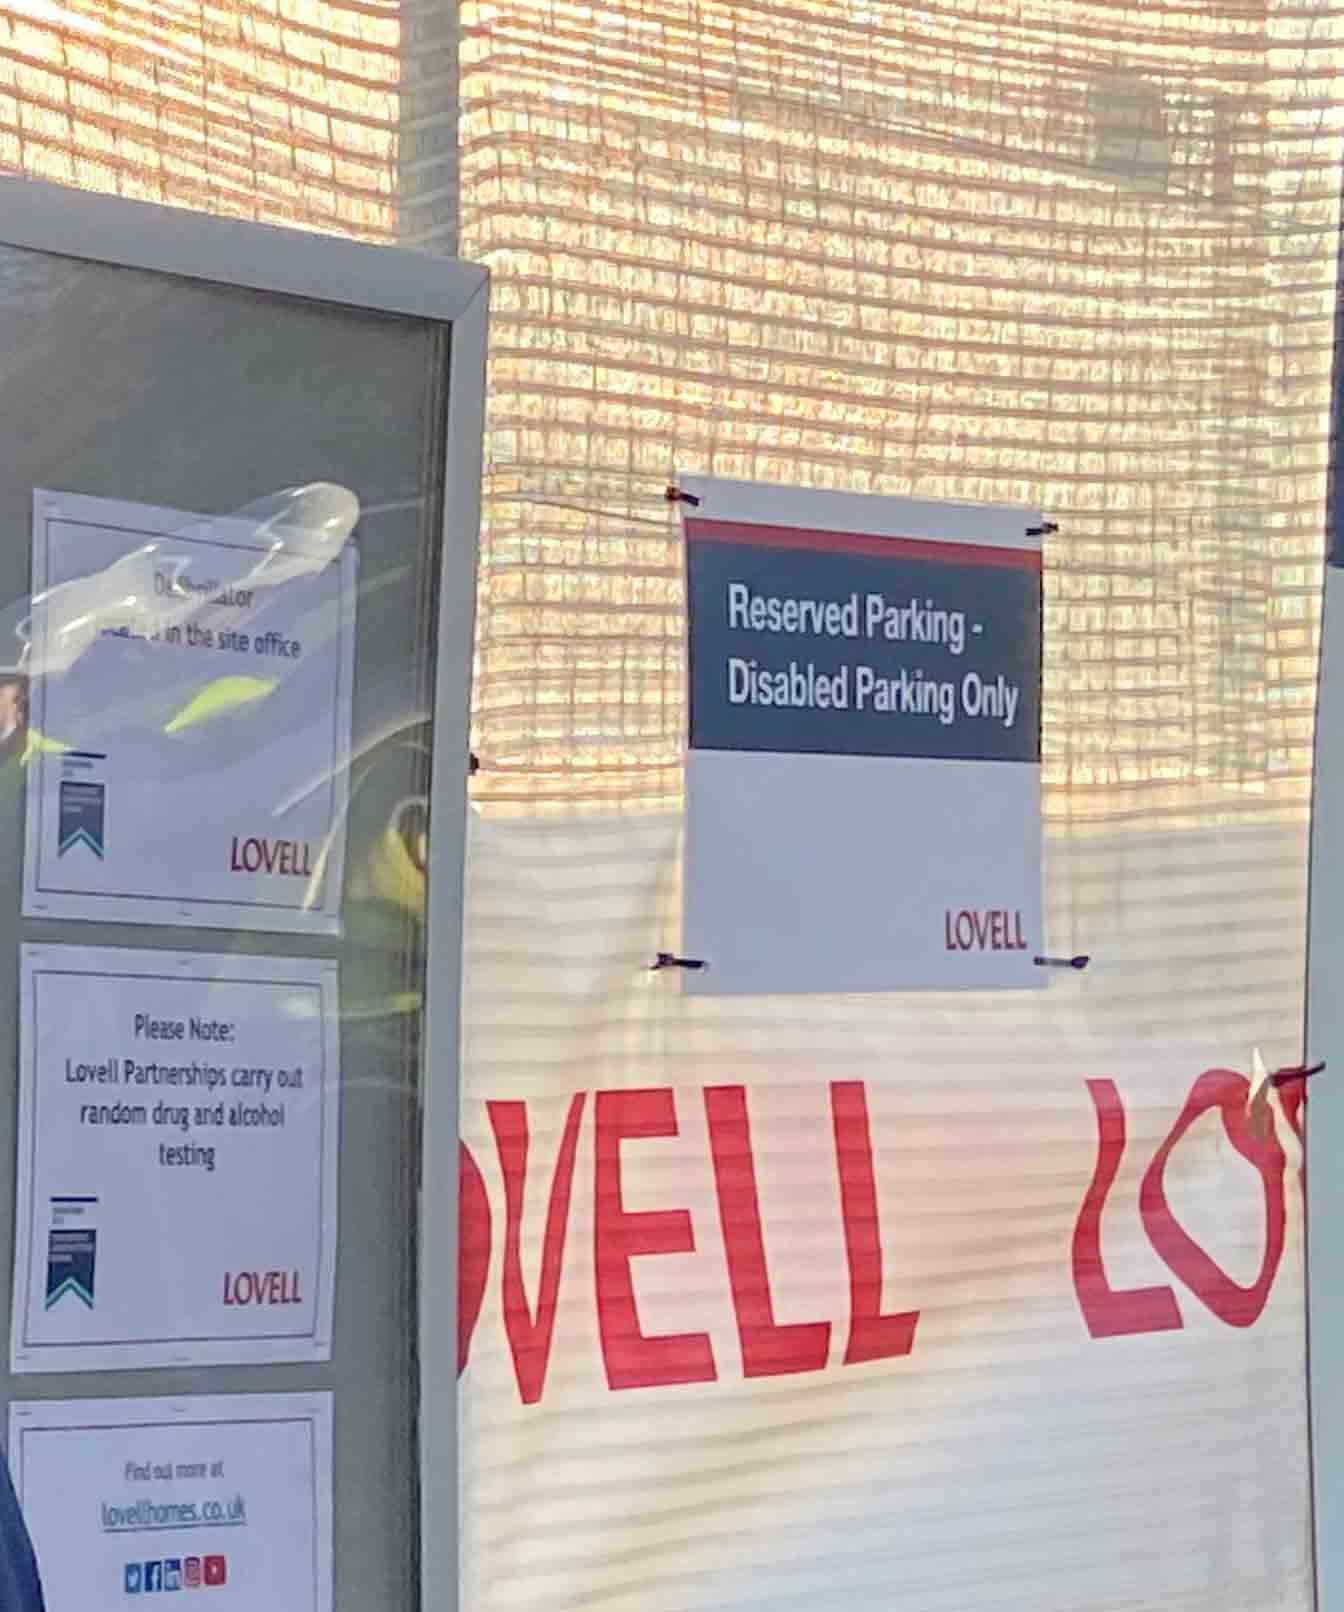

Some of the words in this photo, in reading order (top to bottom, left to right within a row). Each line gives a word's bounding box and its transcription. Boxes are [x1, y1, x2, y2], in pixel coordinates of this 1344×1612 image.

[728, 583, 858, 637] Reserved
[866, 594, 965, 654] Parking
[165, 625, 182, 643] in
[187, 623, 212, 648] the
[218, 630, 250, 652] site
[254, 631, 302, 658] office
[728, 658, 848, 709] Disabled
[856, 667, 955, 725] Parking
[962, 672, 1019, 728] Only
[230, 837, 311, 876] LOVELL
[945, 910, 1028, 951] LOVELL
[134, 1014, 184, 1040] Please
[189, 1017, 236, 1042] Note:
[65, 1058, 119, 1084] Lovell
[124, 1059, 227, 1091] Partnerships
[231, 1067, 272, 1093] carry
[277, 1066, 303, 1089] out
[80, 1100, 147, 1126] random
[152, 1099, 190, 1131] drug
[194, 1102, 224, 1127] and
[229, 1102, 285, 1128] alcohol
[159, 1143, 216, 1171] testing
[1071, 1068, 1306, 1339] LO
[223, 1270, 303, 1305] LOVELL
[125, 1461, 151, 1481] Find
[153, 1463, 173, 1480] out
[176, 1462, 207, 1479] more
[102, 1493, 246, 1527] lovellhomes.co.uk
